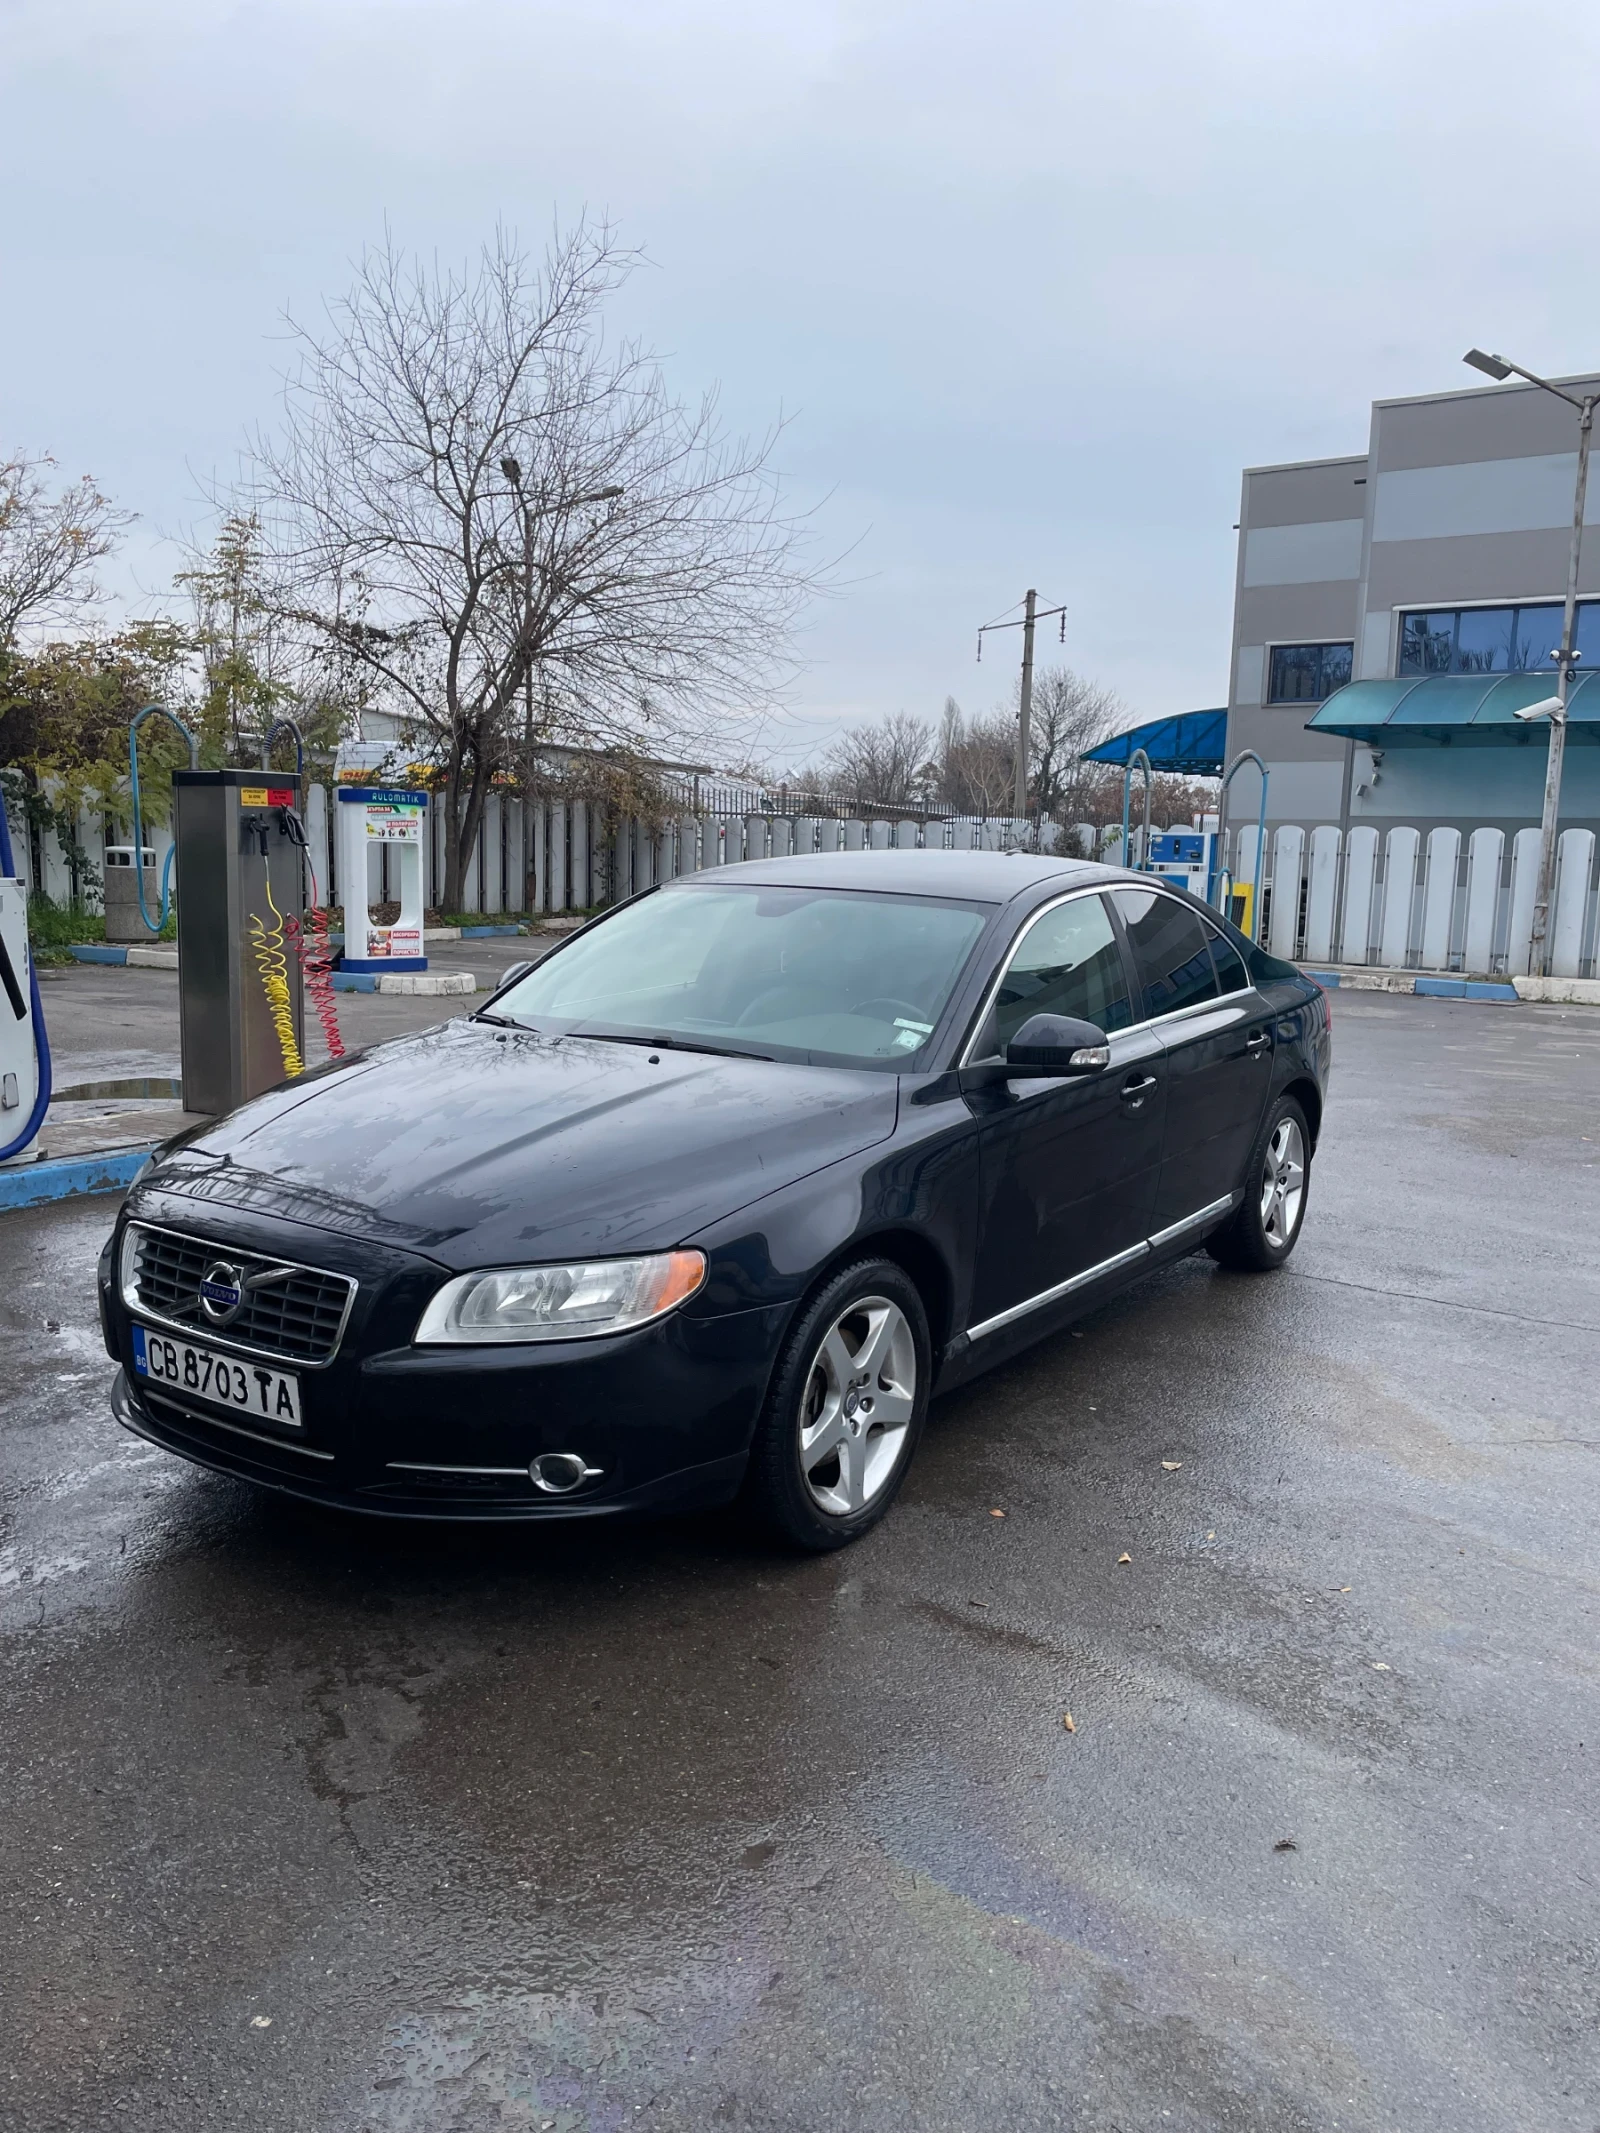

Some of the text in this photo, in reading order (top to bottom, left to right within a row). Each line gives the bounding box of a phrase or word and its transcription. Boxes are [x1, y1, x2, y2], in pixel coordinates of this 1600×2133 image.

[202, 1284, 236, 1301] VOLVO
[136, 1356, 147, 1369] BG
[148, 1337, 295, 1419] CB 8703 TA
